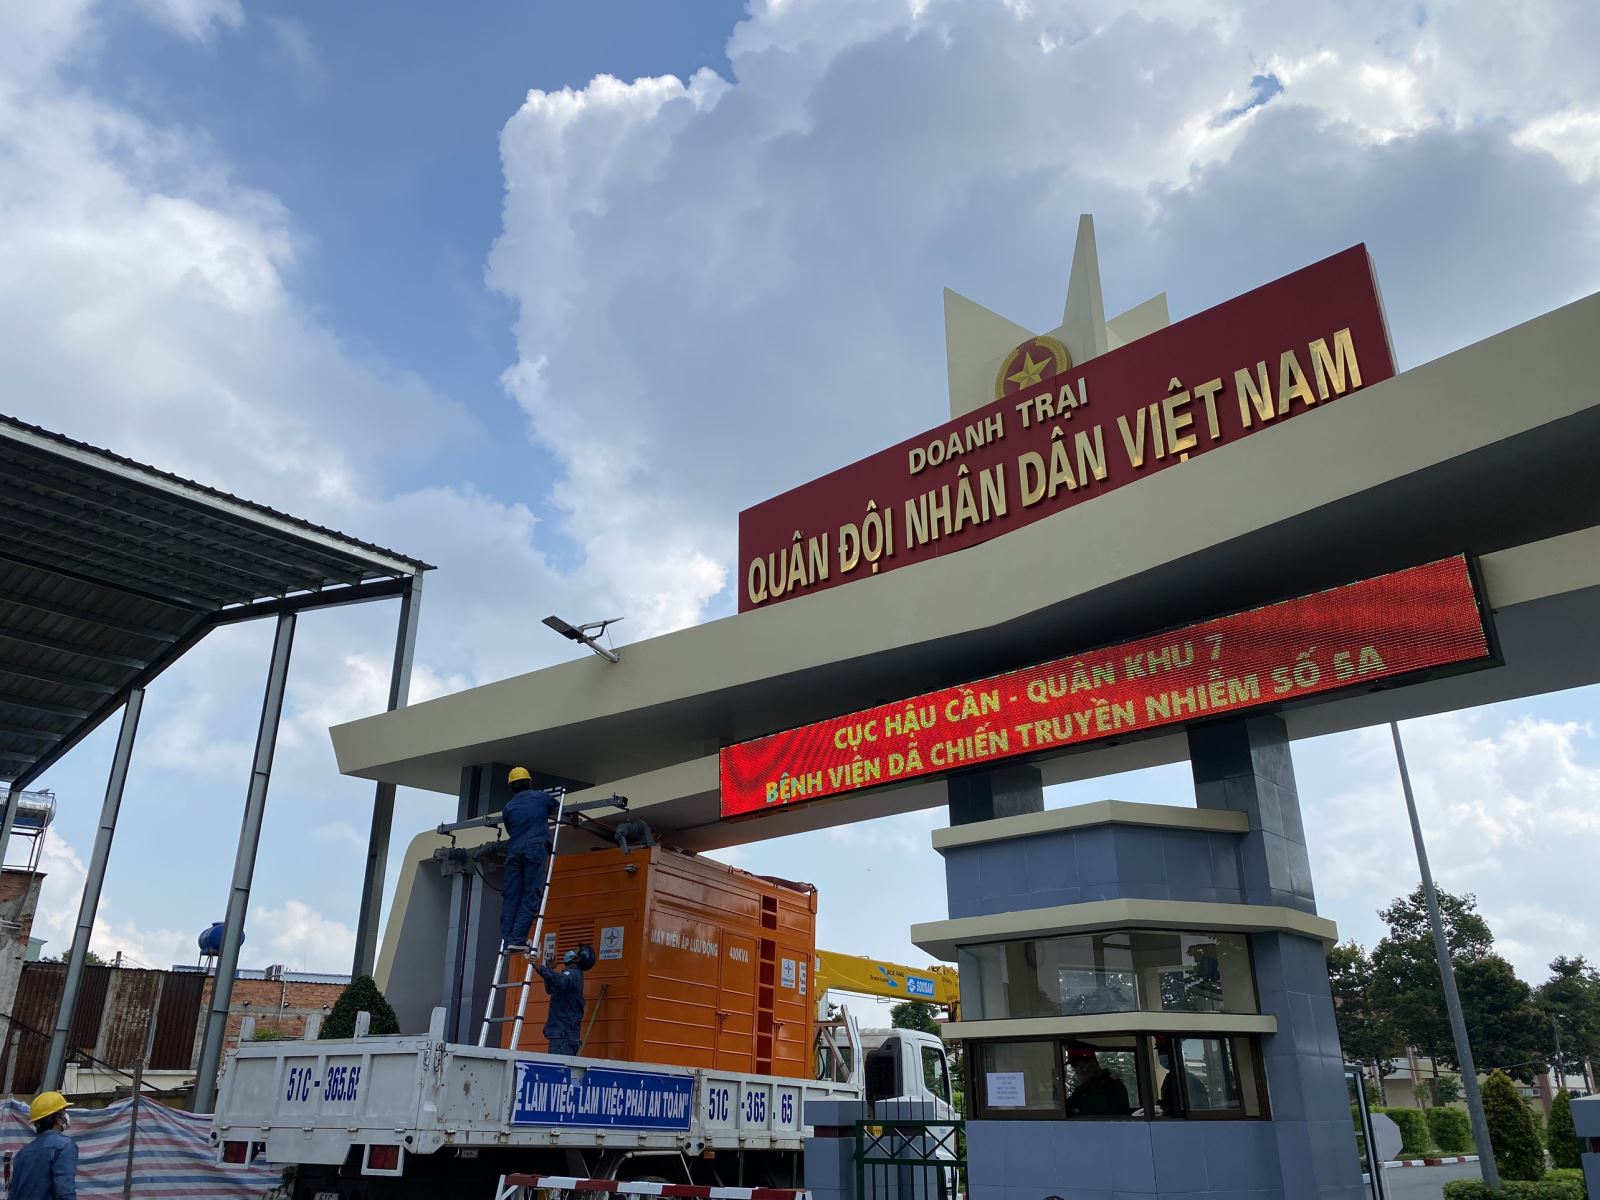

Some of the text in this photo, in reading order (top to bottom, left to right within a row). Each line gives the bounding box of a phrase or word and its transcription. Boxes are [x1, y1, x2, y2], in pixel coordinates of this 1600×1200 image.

[748, 327, 1362, 604] QUÂN ĐỘI NHÂN DÂN VIỆT NAM
[909, 377, 1088, 475] DOANH TRẠI
[765, 772, 823, 805] BỆNH
[829, 755, 881, 788] VIỆN
[888, 741, 925, 777] DÃ
[929, 722, 1010, 767] CHIẾN
[1014, 698, 1136, 748] TRUYỀN
[1144, 666, 1261, 722] NHIỄM
[1271, 646, 1322, 694] SỐ
[834, 719, 877, 751] CỤC
[885, 704, 938, 738] HẬU
[945, 686, 1001, 722] CẦN
[1027, 662, 1116, 704] QUÂN
[1125, 641, 1194, 680] KHU
[1204, 632, 1224, 661] 7
[287, 1067, 312, 1102] 51C
[525, 1074, 548, 1112] LÀM
[551, 1077, 575, 1122] VIỆC,
[578, 1078, 600, 1114] LÀM
[602, 1081, 623, 1124] VIỆC
[625, 1080, 647, 1117] PHẢI
[648, 1091, 661, 1117] AN
[709, 1088, 728, 1121] 51C
